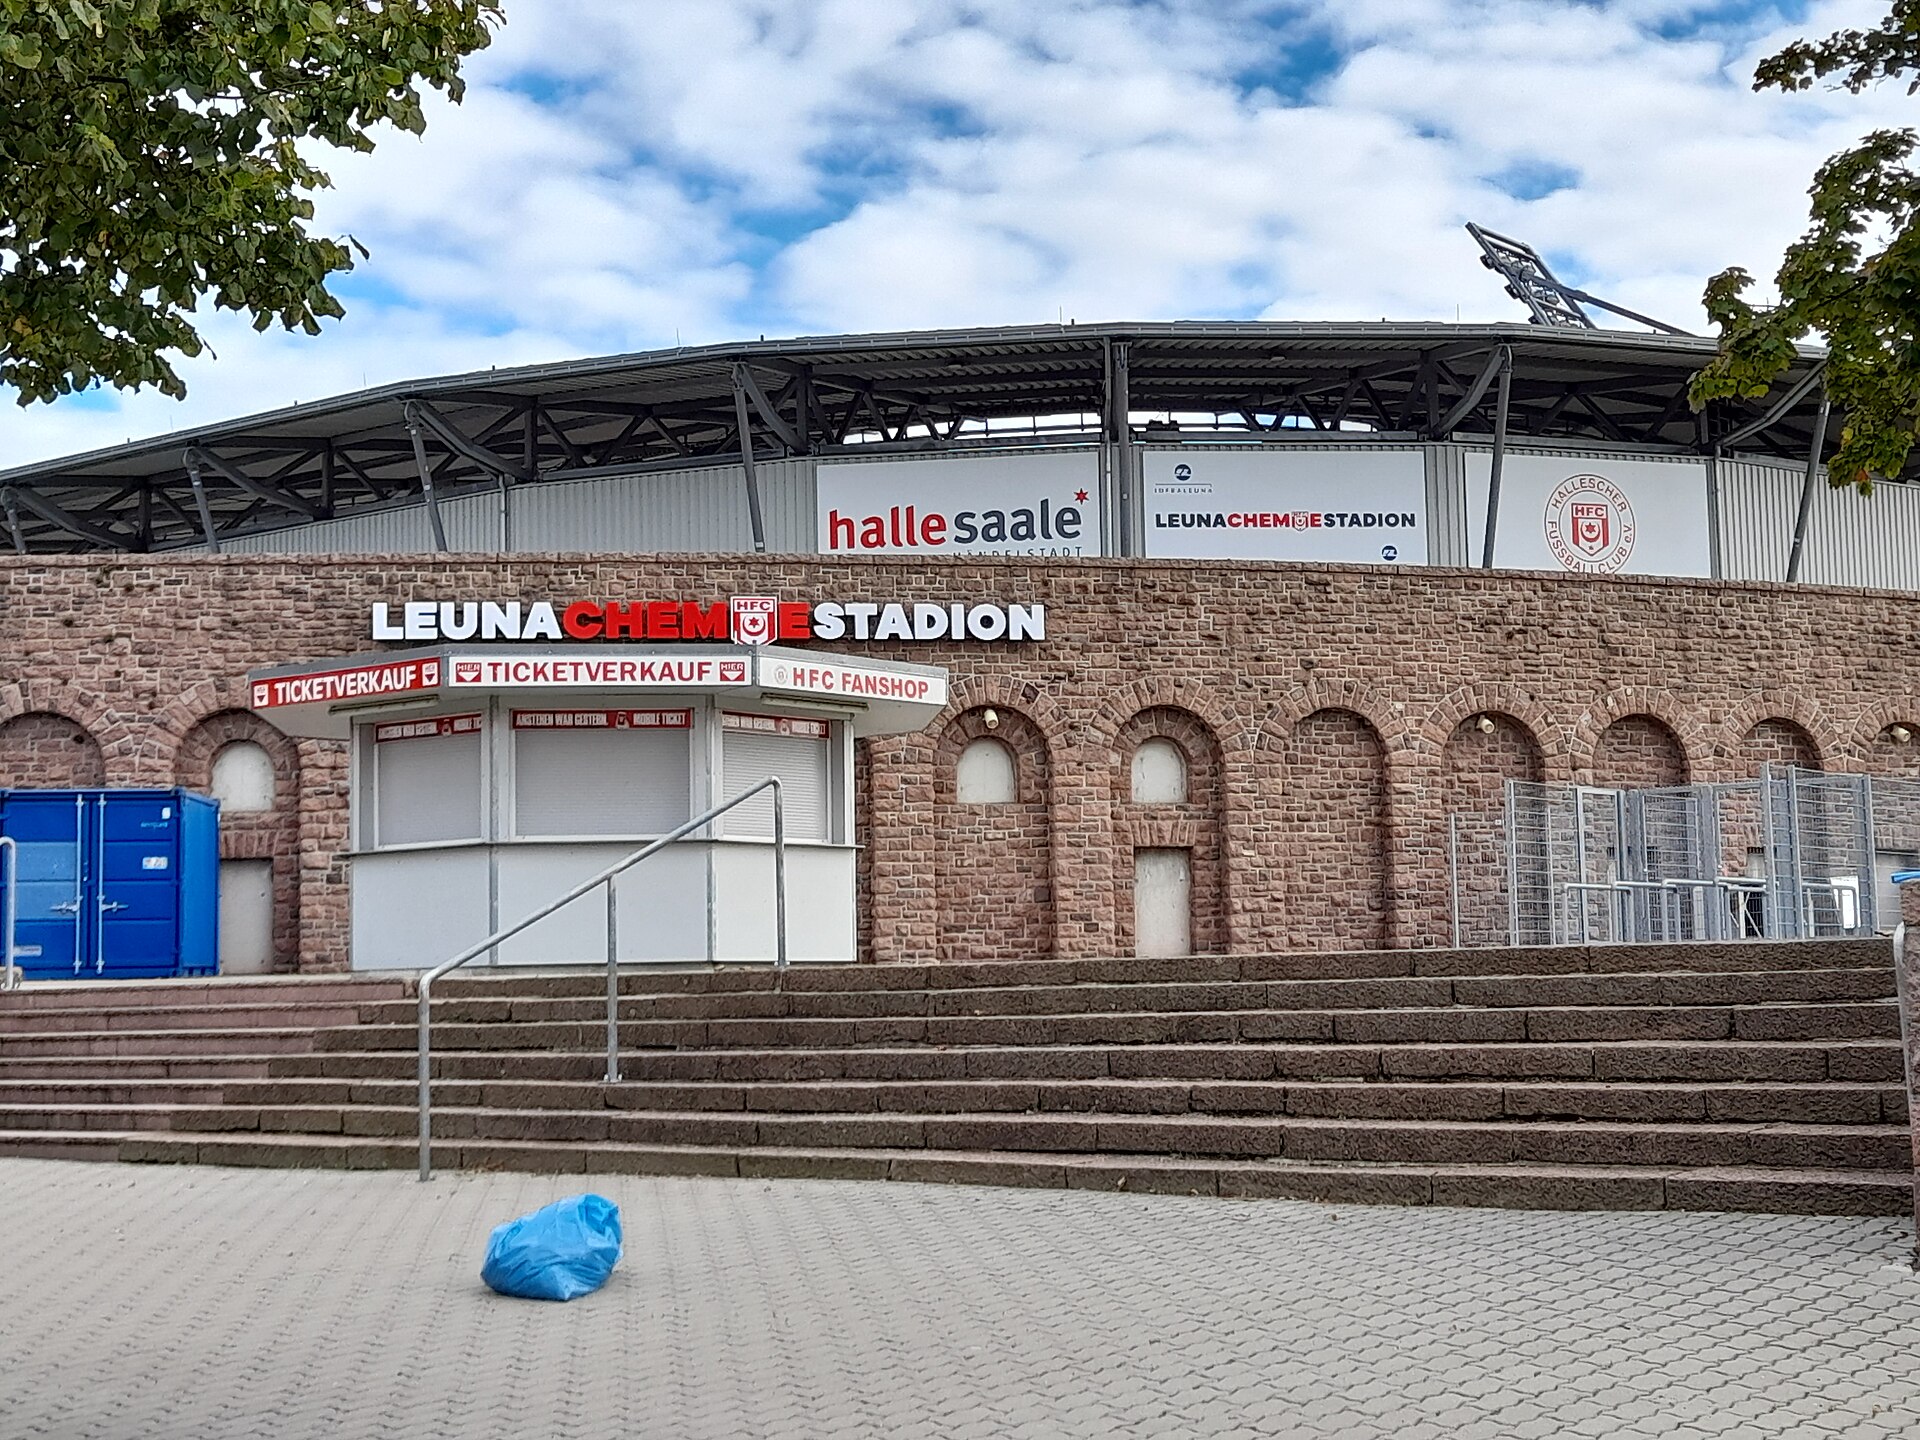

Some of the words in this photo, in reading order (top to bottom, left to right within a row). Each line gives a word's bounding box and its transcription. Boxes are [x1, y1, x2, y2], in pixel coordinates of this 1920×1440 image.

[1551, 478, 1627, 513] HALLESCHER
[1575, 506, 1604, 517] HFC
[737, 601, 771, 610] HFC
[487, 662, 712, 682] TICKETVERKAUF
[274, 665, 416, 704] TICKETVERKAUF
[792, 667, 834, 690] HFC
[842, 672, 929, 699] FANSHOP
[555, 713, 573, 726] WAR
